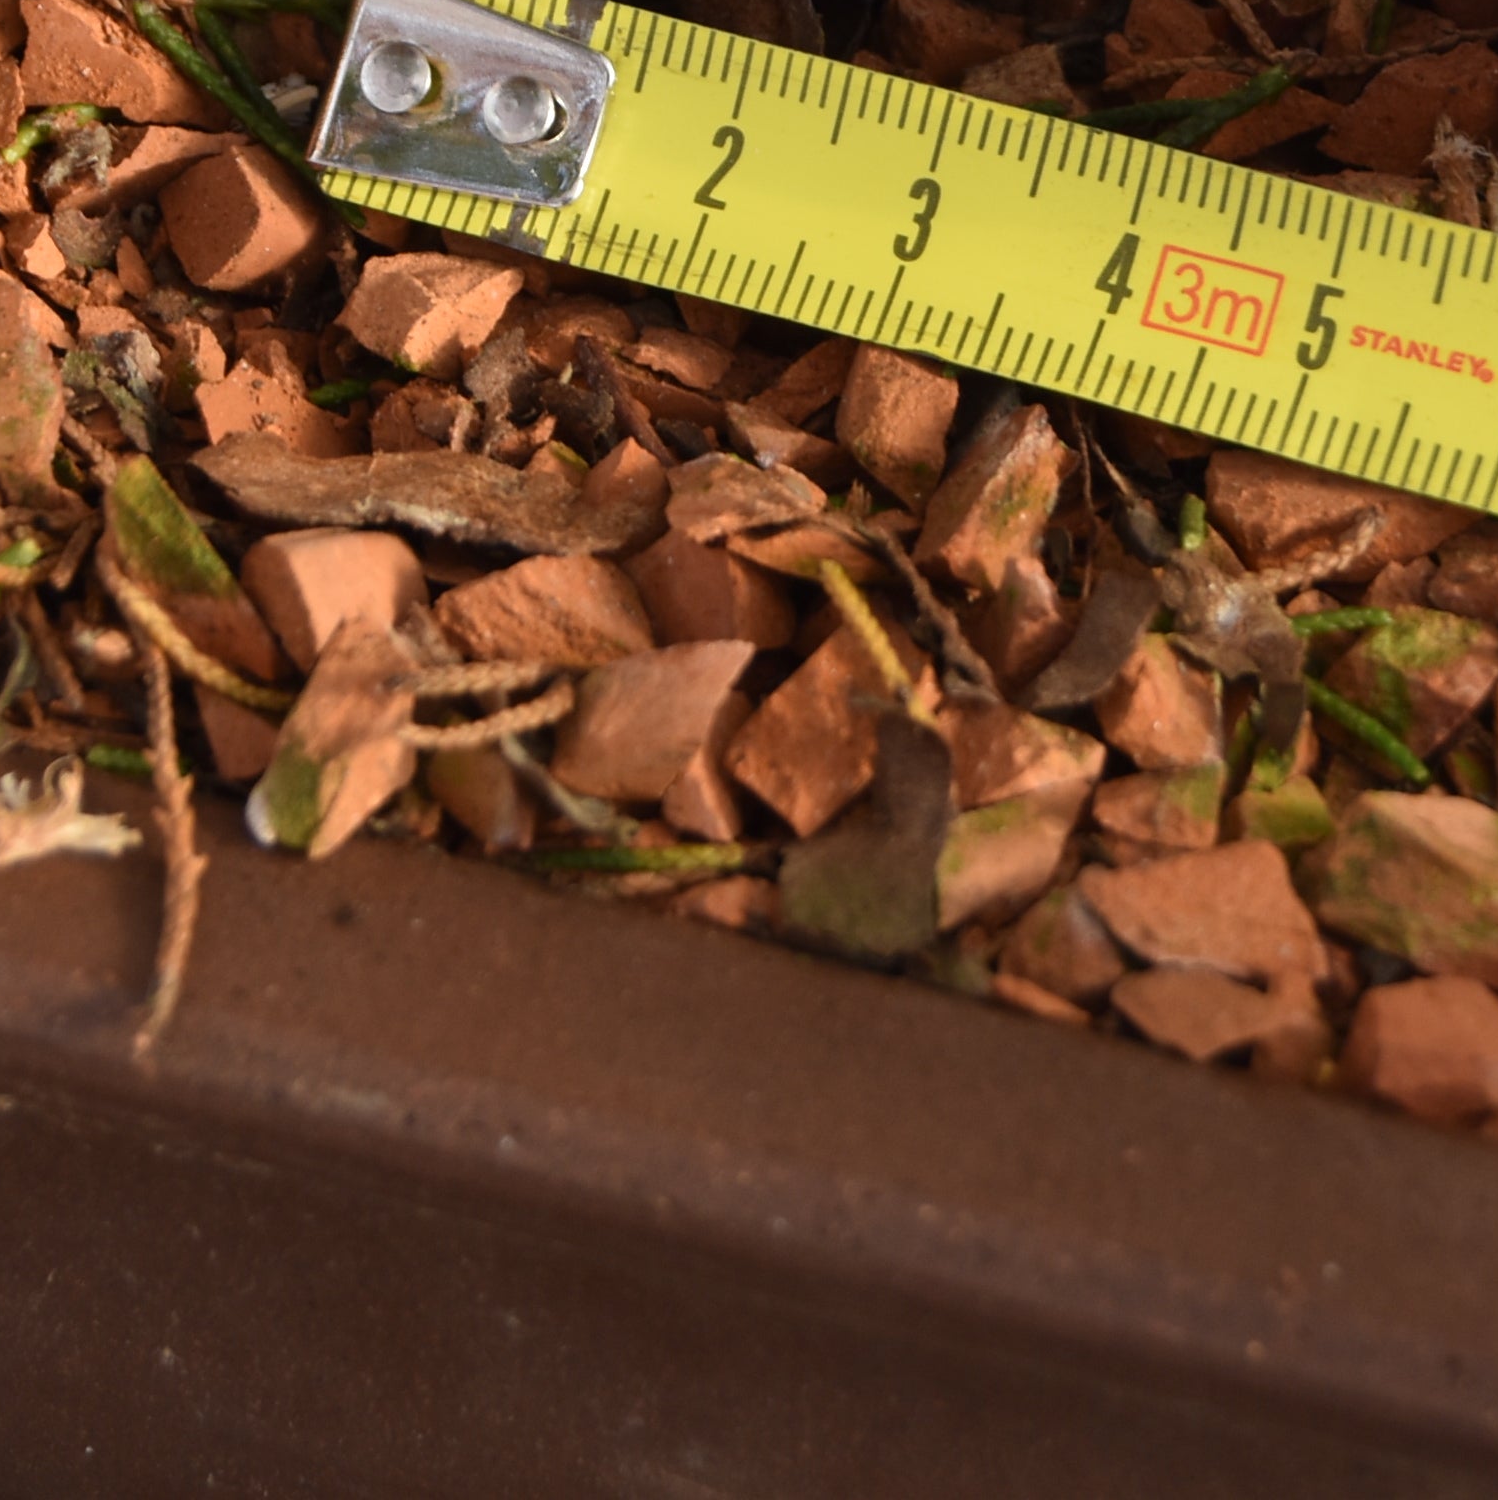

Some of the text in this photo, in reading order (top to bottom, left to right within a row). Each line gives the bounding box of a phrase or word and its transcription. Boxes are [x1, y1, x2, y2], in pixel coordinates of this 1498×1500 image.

[694, 125, 746, 211] 2
[893, 177, 942, 263] 3
[1095, 232, 1142, 315] 4
[1162, 262, 1266, 343] 3m
[1298, 283, 1346, 372] 5
[1350, 324, 1491, 378] STANLEY
